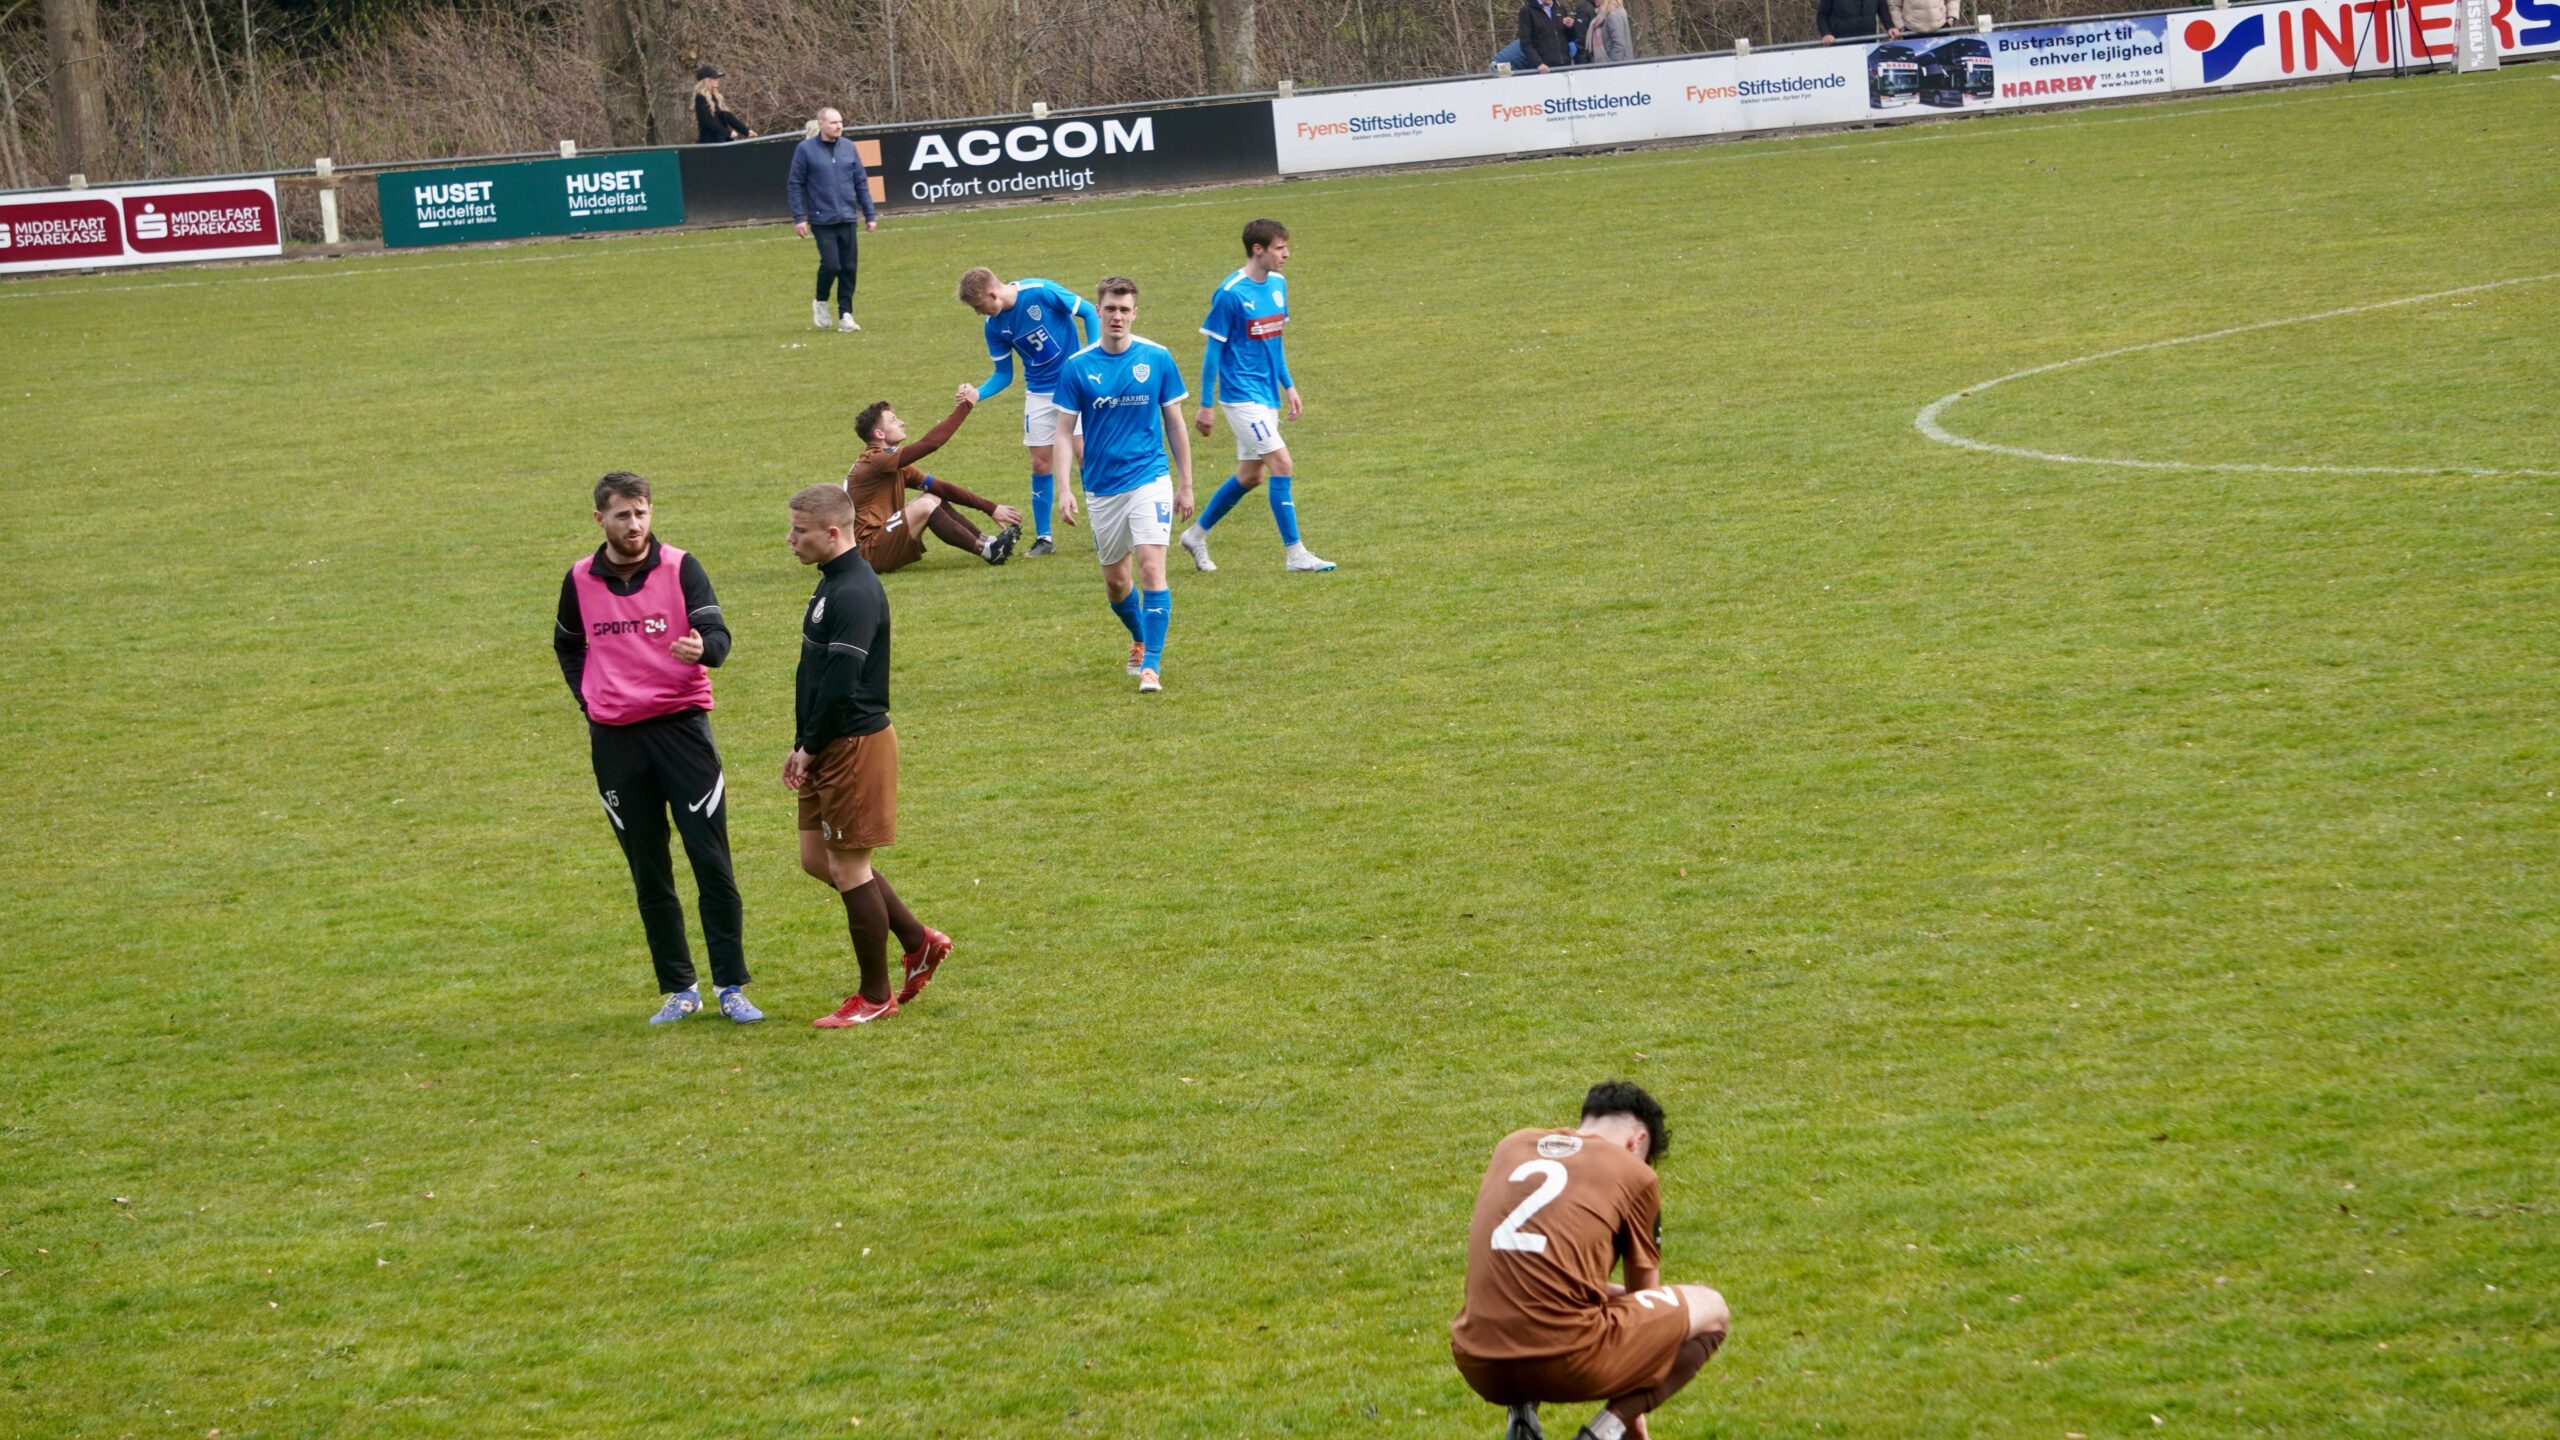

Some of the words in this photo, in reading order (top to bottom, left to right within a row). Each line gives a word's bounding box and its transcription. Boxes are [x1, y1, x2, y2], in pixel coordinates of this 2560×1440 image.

[1999, 29, 2111, 52] Bustransport
[2115, 27, 2132, 40] til
[2030, 52, 2088, 66] enhver
[2091, 42, 2163, 61] lejlighed
[2101, 76, 2165, 89] www.haarby.dk
[2115, 71, 2127, 79] 64
[2129, 70, 2140, 78] 73
[2154, 68, 2164, 76] 14
[2002, 74, 2096, 98] HAARBY
[909, 117, 1155, 171] ACCOM
[566, 169, 644, 194] HUSET
[912, 177, 982, 203] Opført
[987, 168, 1095, 193] ordentligt
[414, 181, 493, 206] HUSET
[568, 191, 647, 210] Middelfart
[171, 206, 261, 225] MIDDELFART
[417, 203, 496, 221] Middelfart
[15, 217, 106, 235] MIDDELFART
[172, 219, 262, 237] SPAREKASSE
[16, 230, 107, 248] SPAREKASSE
[1250, 419, 1271, 441] 11
[593, 620, 640, 636] SPORT
[644, 618, 667, 633] 24
[605, 790, 619, 807] 15
[1491, 1159, 1568, 1253] 2
[1634, 1286, 1681, 1310] 2
